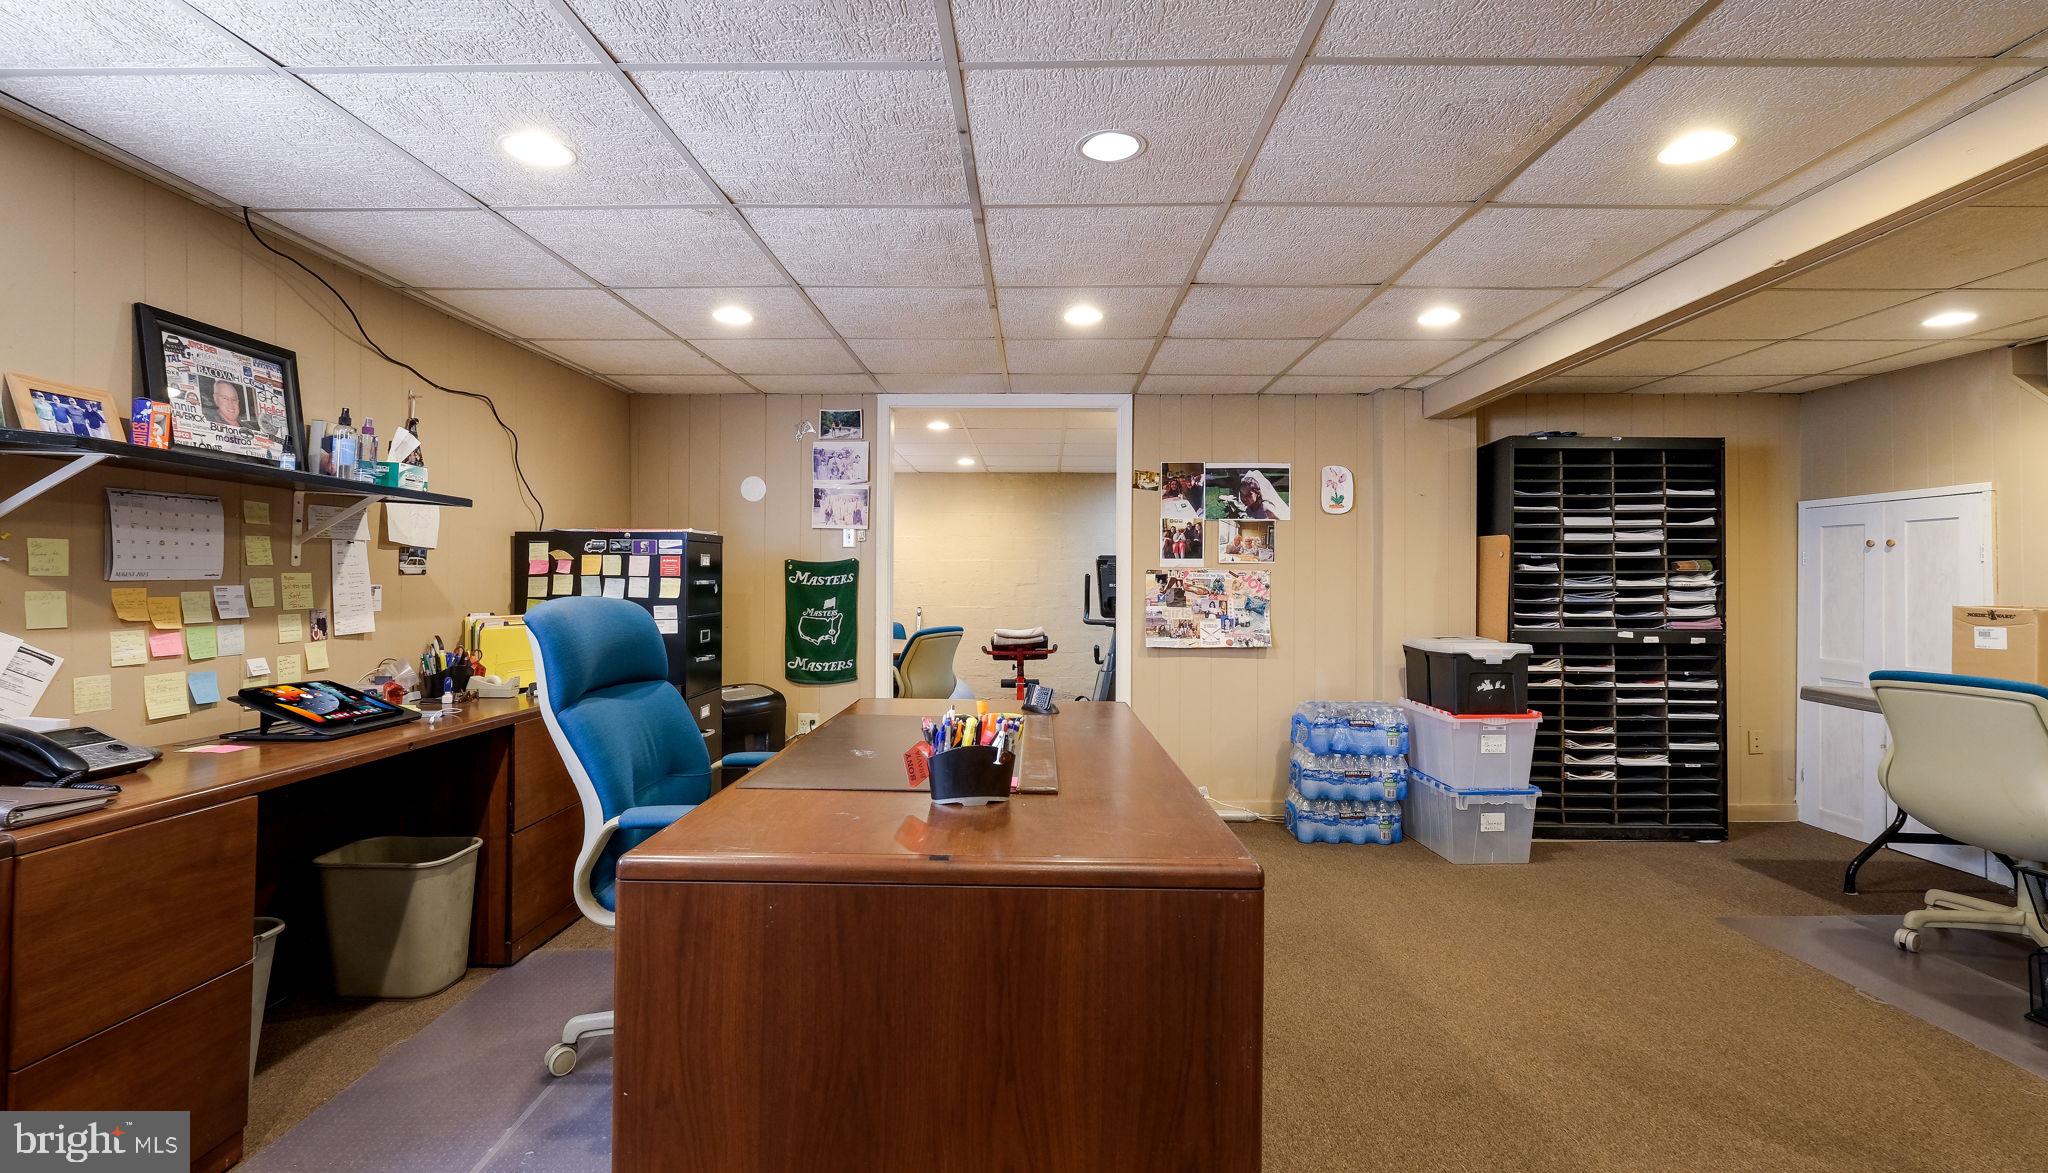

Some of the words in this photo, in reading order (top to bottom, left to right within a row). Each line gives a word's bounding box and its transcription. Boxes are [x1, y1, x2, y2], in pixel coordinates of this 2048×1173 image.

[259, 402, 285, 417] Heller
[210, 421, 239, 436] Burton
[788, 570, 855, 586] MASTERS
[802, 608, 838, 617] MASTERS
[787, 656, 854, 672] MASTERS
